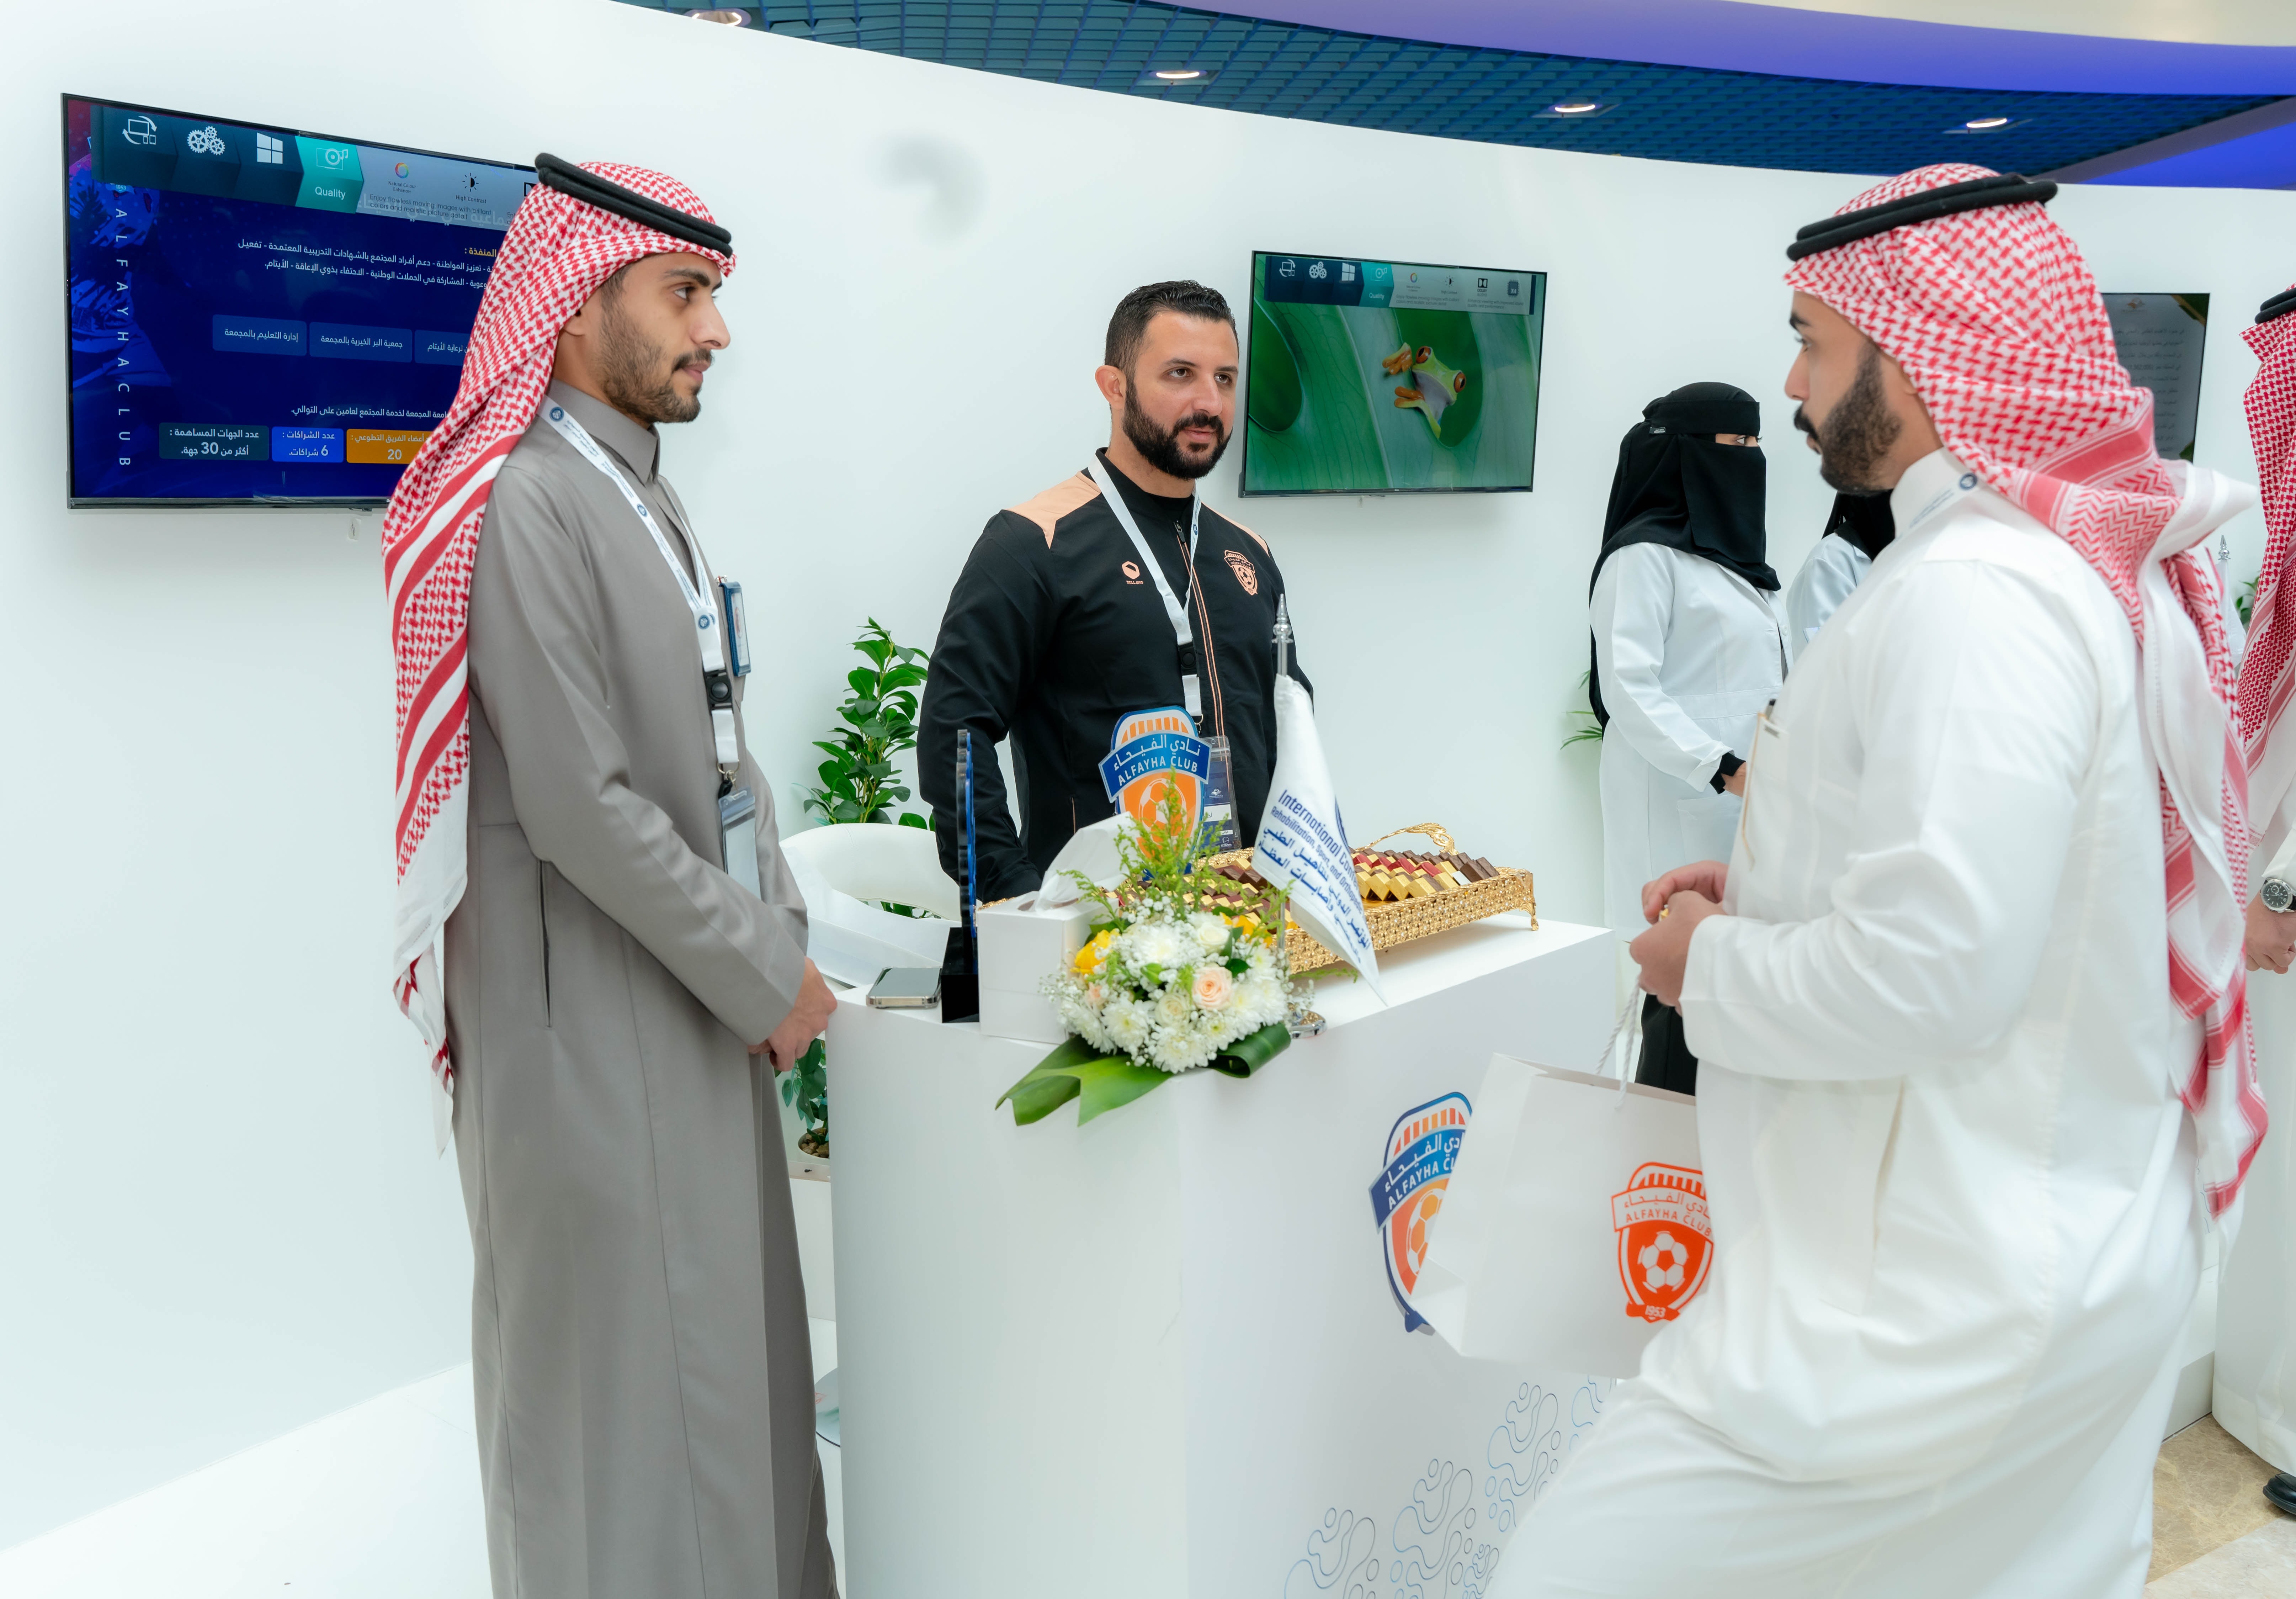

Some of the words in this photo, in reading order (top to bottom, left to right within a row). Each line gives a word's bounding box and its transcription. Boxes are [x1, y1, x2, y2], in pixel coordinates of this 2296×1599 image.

[315, 186, 346, 200] Quality
[370, 194, 386, 202] Enjoy
[388, 196, 411, 205] flawless
[413, 200, 435, 209] moving
[436, 202, 458, 211] images
[472, 207, 491, 216] brillant
[404, 206, 426, 214] realistic
[238, 239, 262, 249] تفعيل
[269, 243, 302, 253] المعتمدة
[304, 246, 332, 256] التدريبية
[333, 249, 369, 261] بالشهادات
[468, 247, 496, 257] المنفذة
[265, 259, 288, 269] الأيتام.
[371, 255, 396, 263] المجتمع
[398, 254, 415, 264] أفراد
[416, 260, 431, 268] دعم
[295, 262, 318, 273] الإعاقة
[437, 260, 464, 270] المواطنة
[466, 264, 482, 272] تعزيز
[320, 266, 338, 275] بذوي
[340, 266, 364, 276] الاحتفاء
[371, 270, 395, 280] الوطنية
[396, 272, 421, 281] الحملات
[423, 276, 435, 285] في
[436, 276, 464, 286] المشاركة
[470, 280, 487, 289] وعوية
[1369, 292, 1385, 301] Quality
[224, 328, 255, 338] بالمجمعة
[257, 330, 281, 341] التعليم
[283, 332, 298, 343] إدارة
[321, 335, 349, 345] بالمجمعة
[351, 337, 371, 346] الخيرية
[372, 339, 382, 347] البر
[383, 339, 403, 349] جمعية
[427, 342, 446, 352] الأيتام
[447, 344, 463, 353] لرعاية
[291, 405, 318, 415] التوالي.
[336, 407, 358, 416] لعامين
[359, 408, 384, 418] المجتمع
[406, 409, 431, 419] المجمعة
[175, 428, 215, 437] المساهمة
[217, 429, 243, 440] الجهات
[287, 430, 319, 440] الشراكات
[408, 433, 424, 442] أعضاء
[355, 434, 384, 443] التطوعي
[386, 434, 406, 443] الفريق
[181, 446, 198, 457] جهة.
[201, 442, 218, 455] 30
[220, 448, 232, 456] من
[234, 444, 249, 457] أكثر
[289, 448, 318, 457] شراكات.
[321, 445, 329, 456] 6
[387, 449, 402, 460] 20
[1170, 738, 1201, 756] نادي
[1114, 734, 1167, 771] الفيحاء
[1118, 756, 1166, 787] ALFAYHA
[1170, 756, 1198, 773] CLUB
[1278, 789, 1342, 857] International
[1263, 827, 1296, 849] الطبي
[1271, 806, 1315, 848] Rehabilitation,
[1316, 844, 1330, 868] Sport,
[1329, 864, 1342, 880] and
[1329, 885, 1351, 916] الدولي
[1346, 918, 1371, 950] المؤتمر
[1385, 1133, 1442, 1193] الفيحاء
[1388, 1161, 1439, 1210] ALFAYHA
[1443, 1157, 1455, 1171] CL
[1624, 1192, 1684, 1208] الفيحاء
[1686, 1202, 1710, 1219] ادي
[1626, 1209, 1678, 1223] ALFAYHA
[1683, 1214, 1712, 1236] CLUB
[1645, 1305, 1666, 1318] 1953
